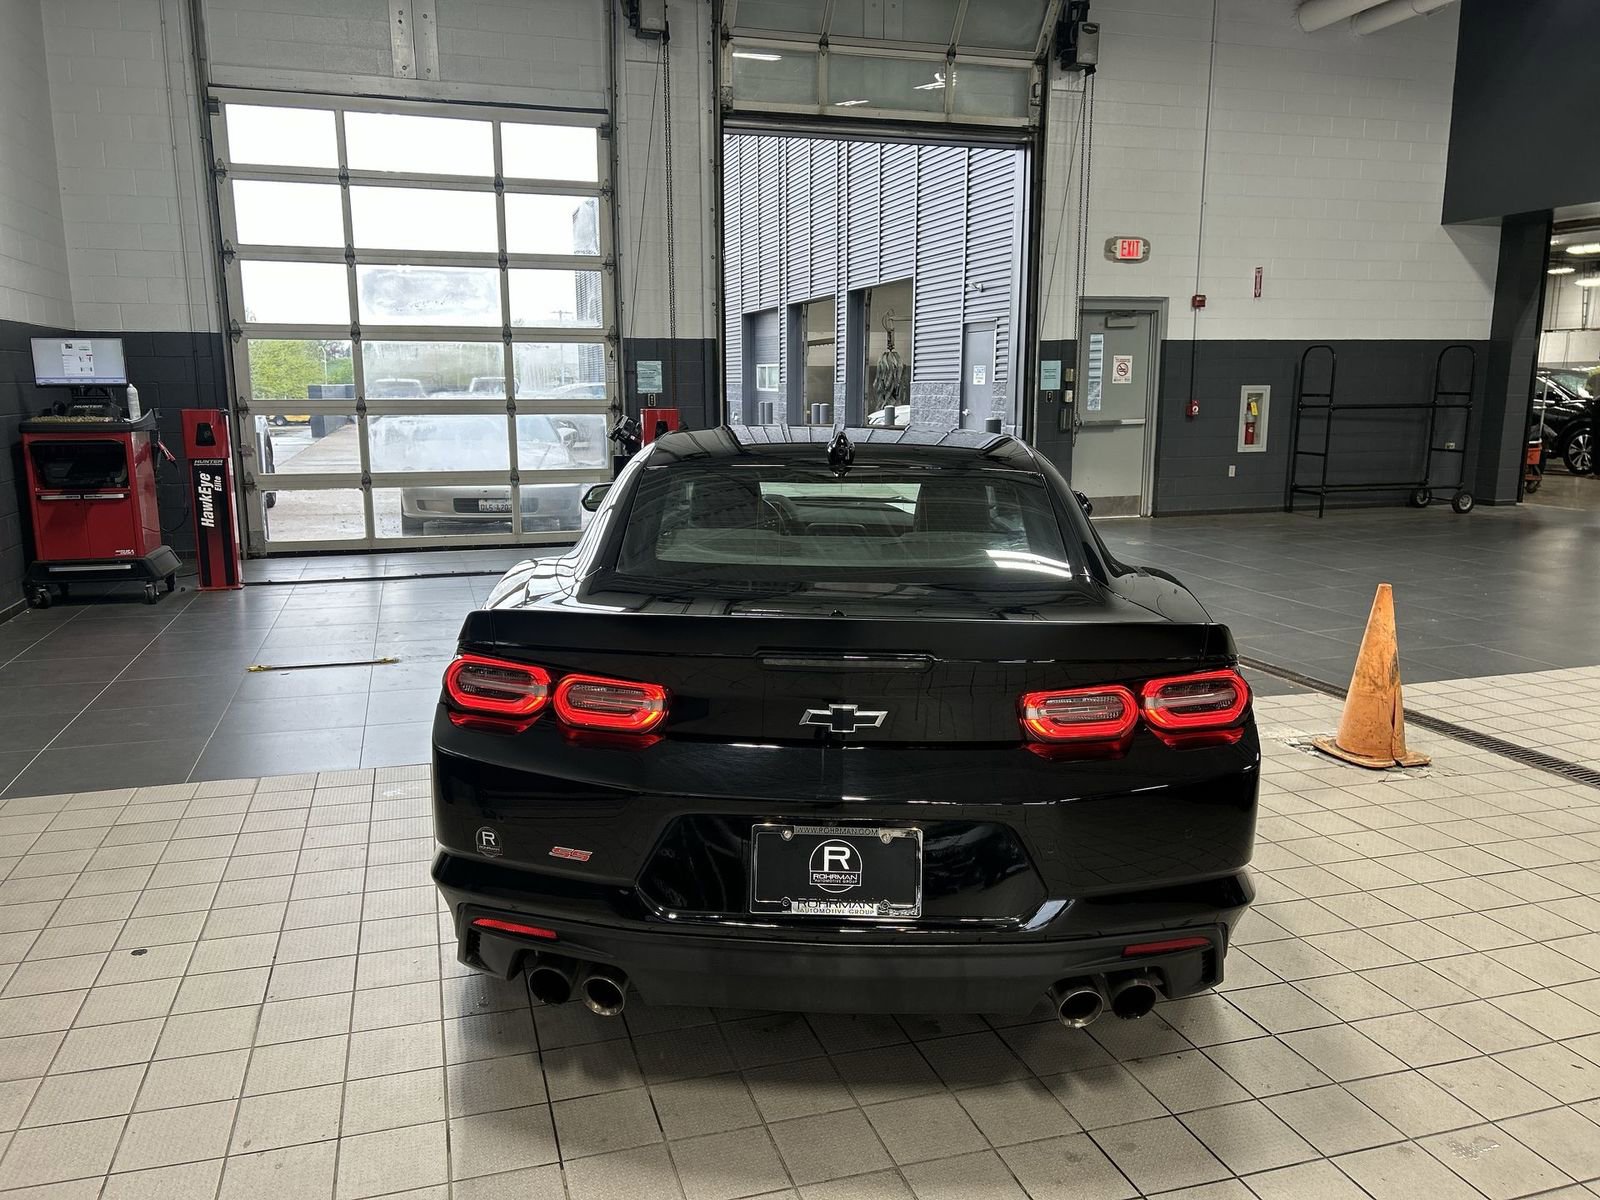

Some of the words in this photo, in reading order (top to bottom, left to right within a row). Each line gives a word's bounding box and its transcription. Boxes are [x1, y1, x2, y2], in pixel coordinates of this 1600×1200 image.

[1121, 240, 1140, 257] EXIT
[214, 475, 222, 491] Elite
[198, 472, 215, 527] HawkEye
[481, 831, 495, 846] R
[796, 827, 879, 836] WWW.ROHRMAN.COM
[548, 846, 593, 862] SS
[823, 846, 851, 872] R
[797, 898, 874, 909] ROHRMAN
